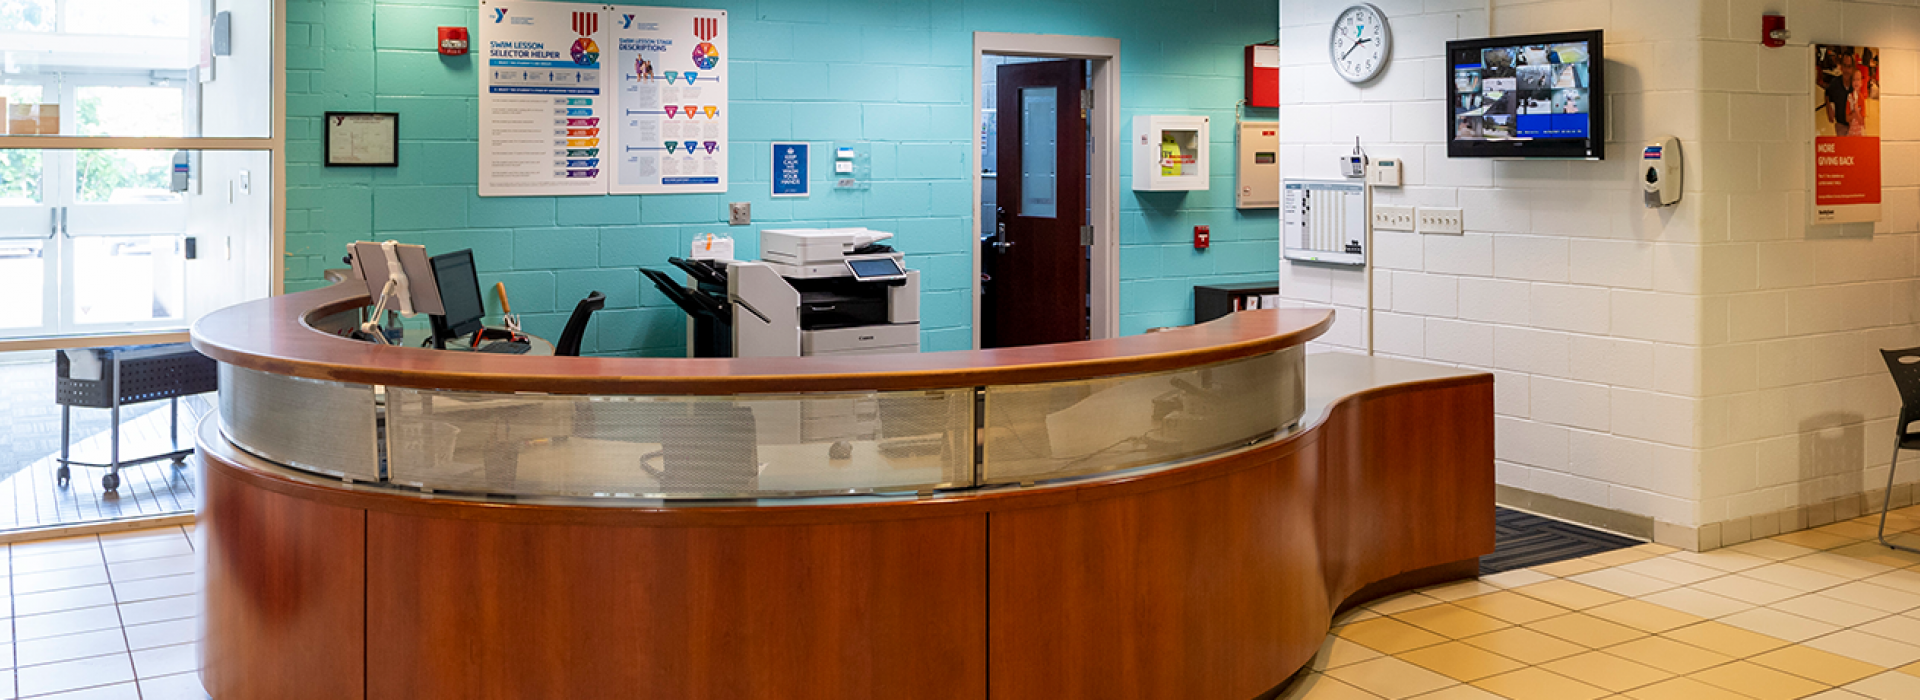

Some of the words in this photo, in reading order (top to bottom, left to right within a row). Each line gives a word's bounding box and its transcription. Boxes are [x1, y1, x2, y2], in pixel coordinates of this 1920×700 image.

[490, 40, 511, 48] SWIM
[514, 41, 543, 50] LESSON
[619, 44, 666, 52] DESCRIPTIONS
[490, 49, 529, 58] SELECTOR
[531, 50, 560, 58] HELPER
[1817, 143, 1835, 152] MORE
[1818, 156, 1838, 166] GIVING
[1839, 156, 1854, 166] BACK
